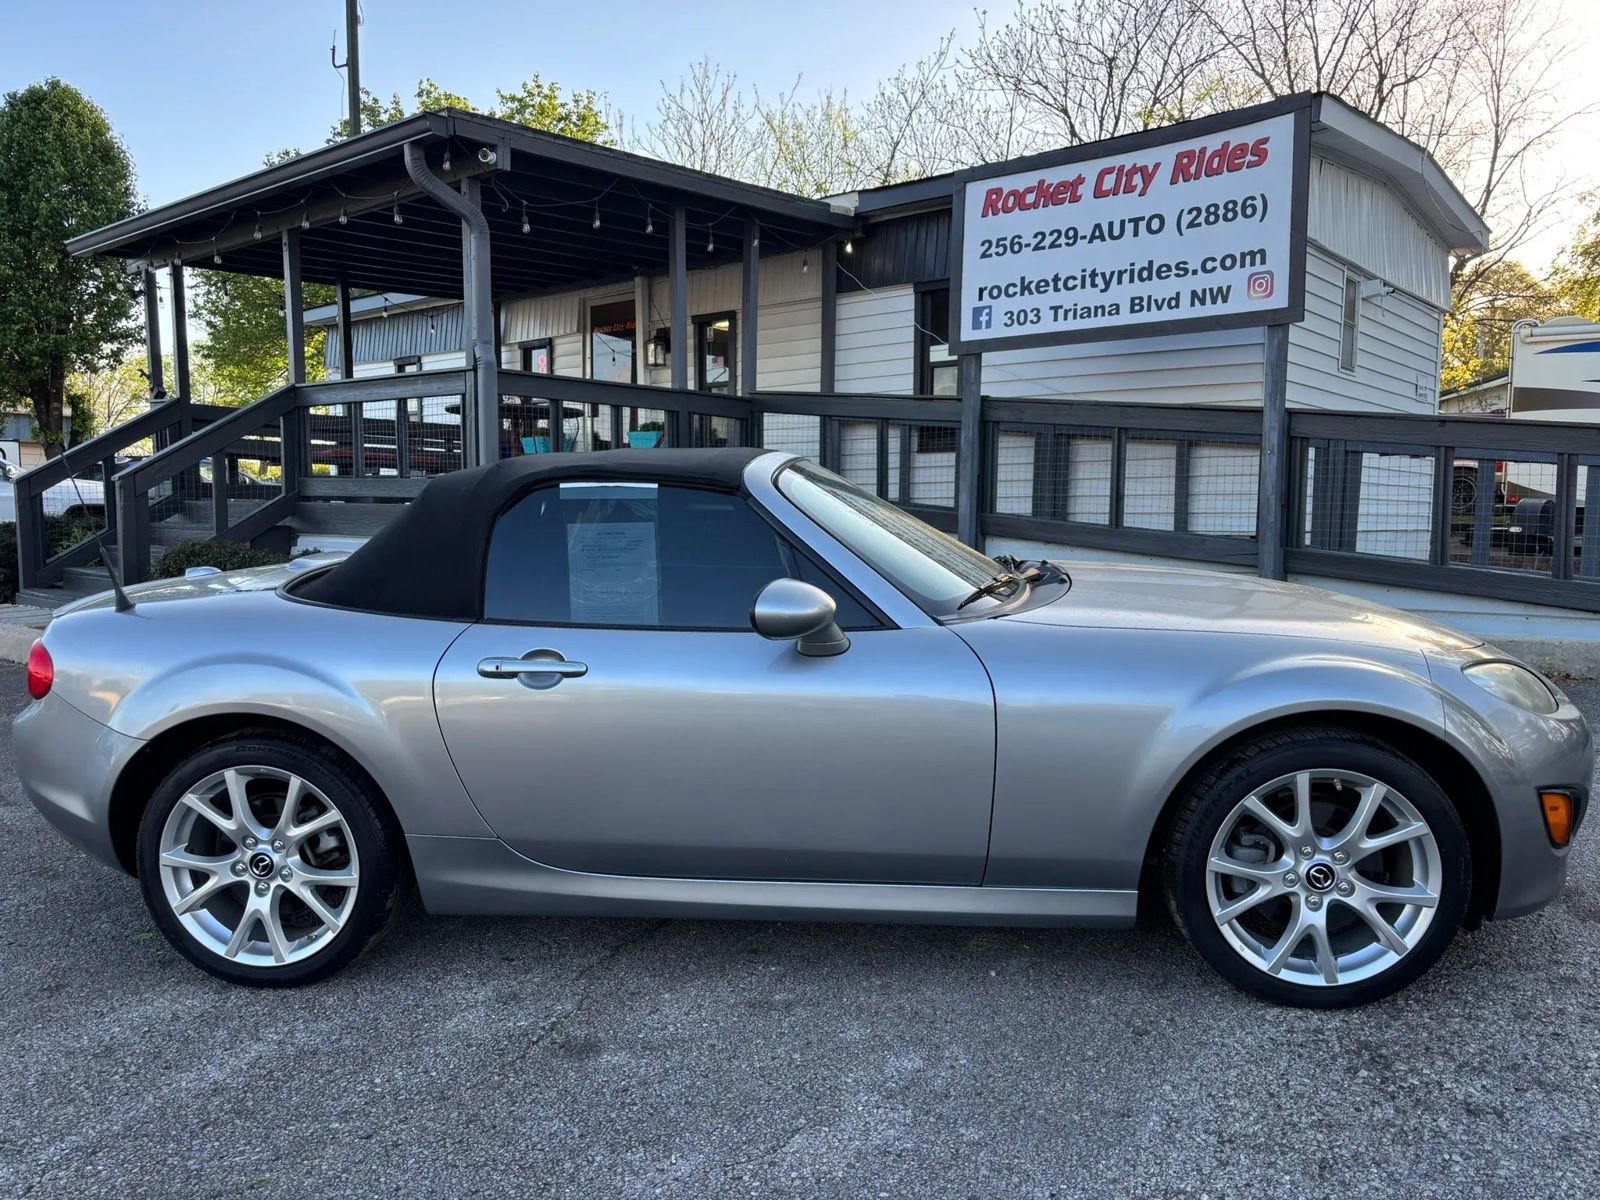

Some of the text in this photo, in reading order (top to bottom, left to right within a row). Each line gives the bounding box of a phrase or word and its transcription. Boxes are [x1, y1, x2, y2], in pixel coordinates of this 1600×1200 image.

[981, 136, 1271, 218] Rocket City Rides
[979, 193, 1269, 259] 256-229-AUTO (2886)
[977, 248, 1268, 302] rocketcityrides.com
[1003, 284, 1233, 328] 303 Triana Blvd NW
